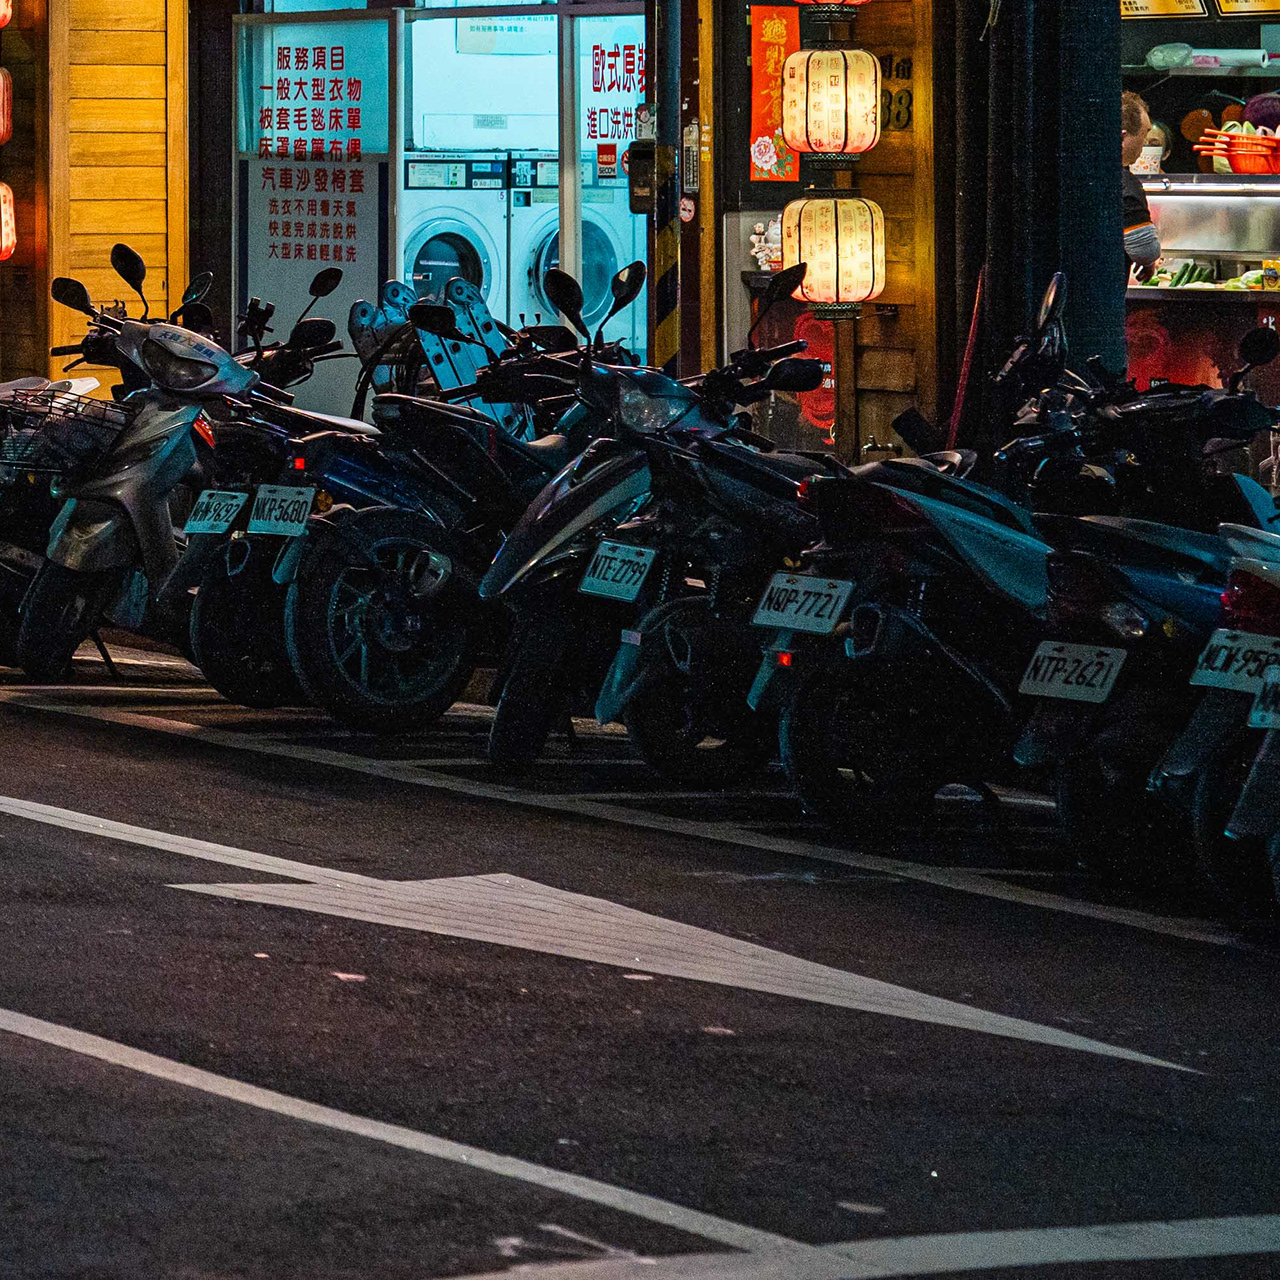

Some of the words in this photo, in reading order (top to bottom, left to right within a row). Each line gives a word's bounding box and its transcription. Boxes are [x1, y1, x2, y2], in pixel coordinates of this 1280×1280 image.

[276, 46, 345, 72] 服務項目
[259, 76, 362, 102] 一般大型衣物
[259, 107, 361, 132] 被套毛毯床單
[258, 136, 362, 162] 床罩窗簾布偶
[260, 166, 364, 194] 汽車沙發椅套
[1025, 655, 1114, 688] NTP-2621
